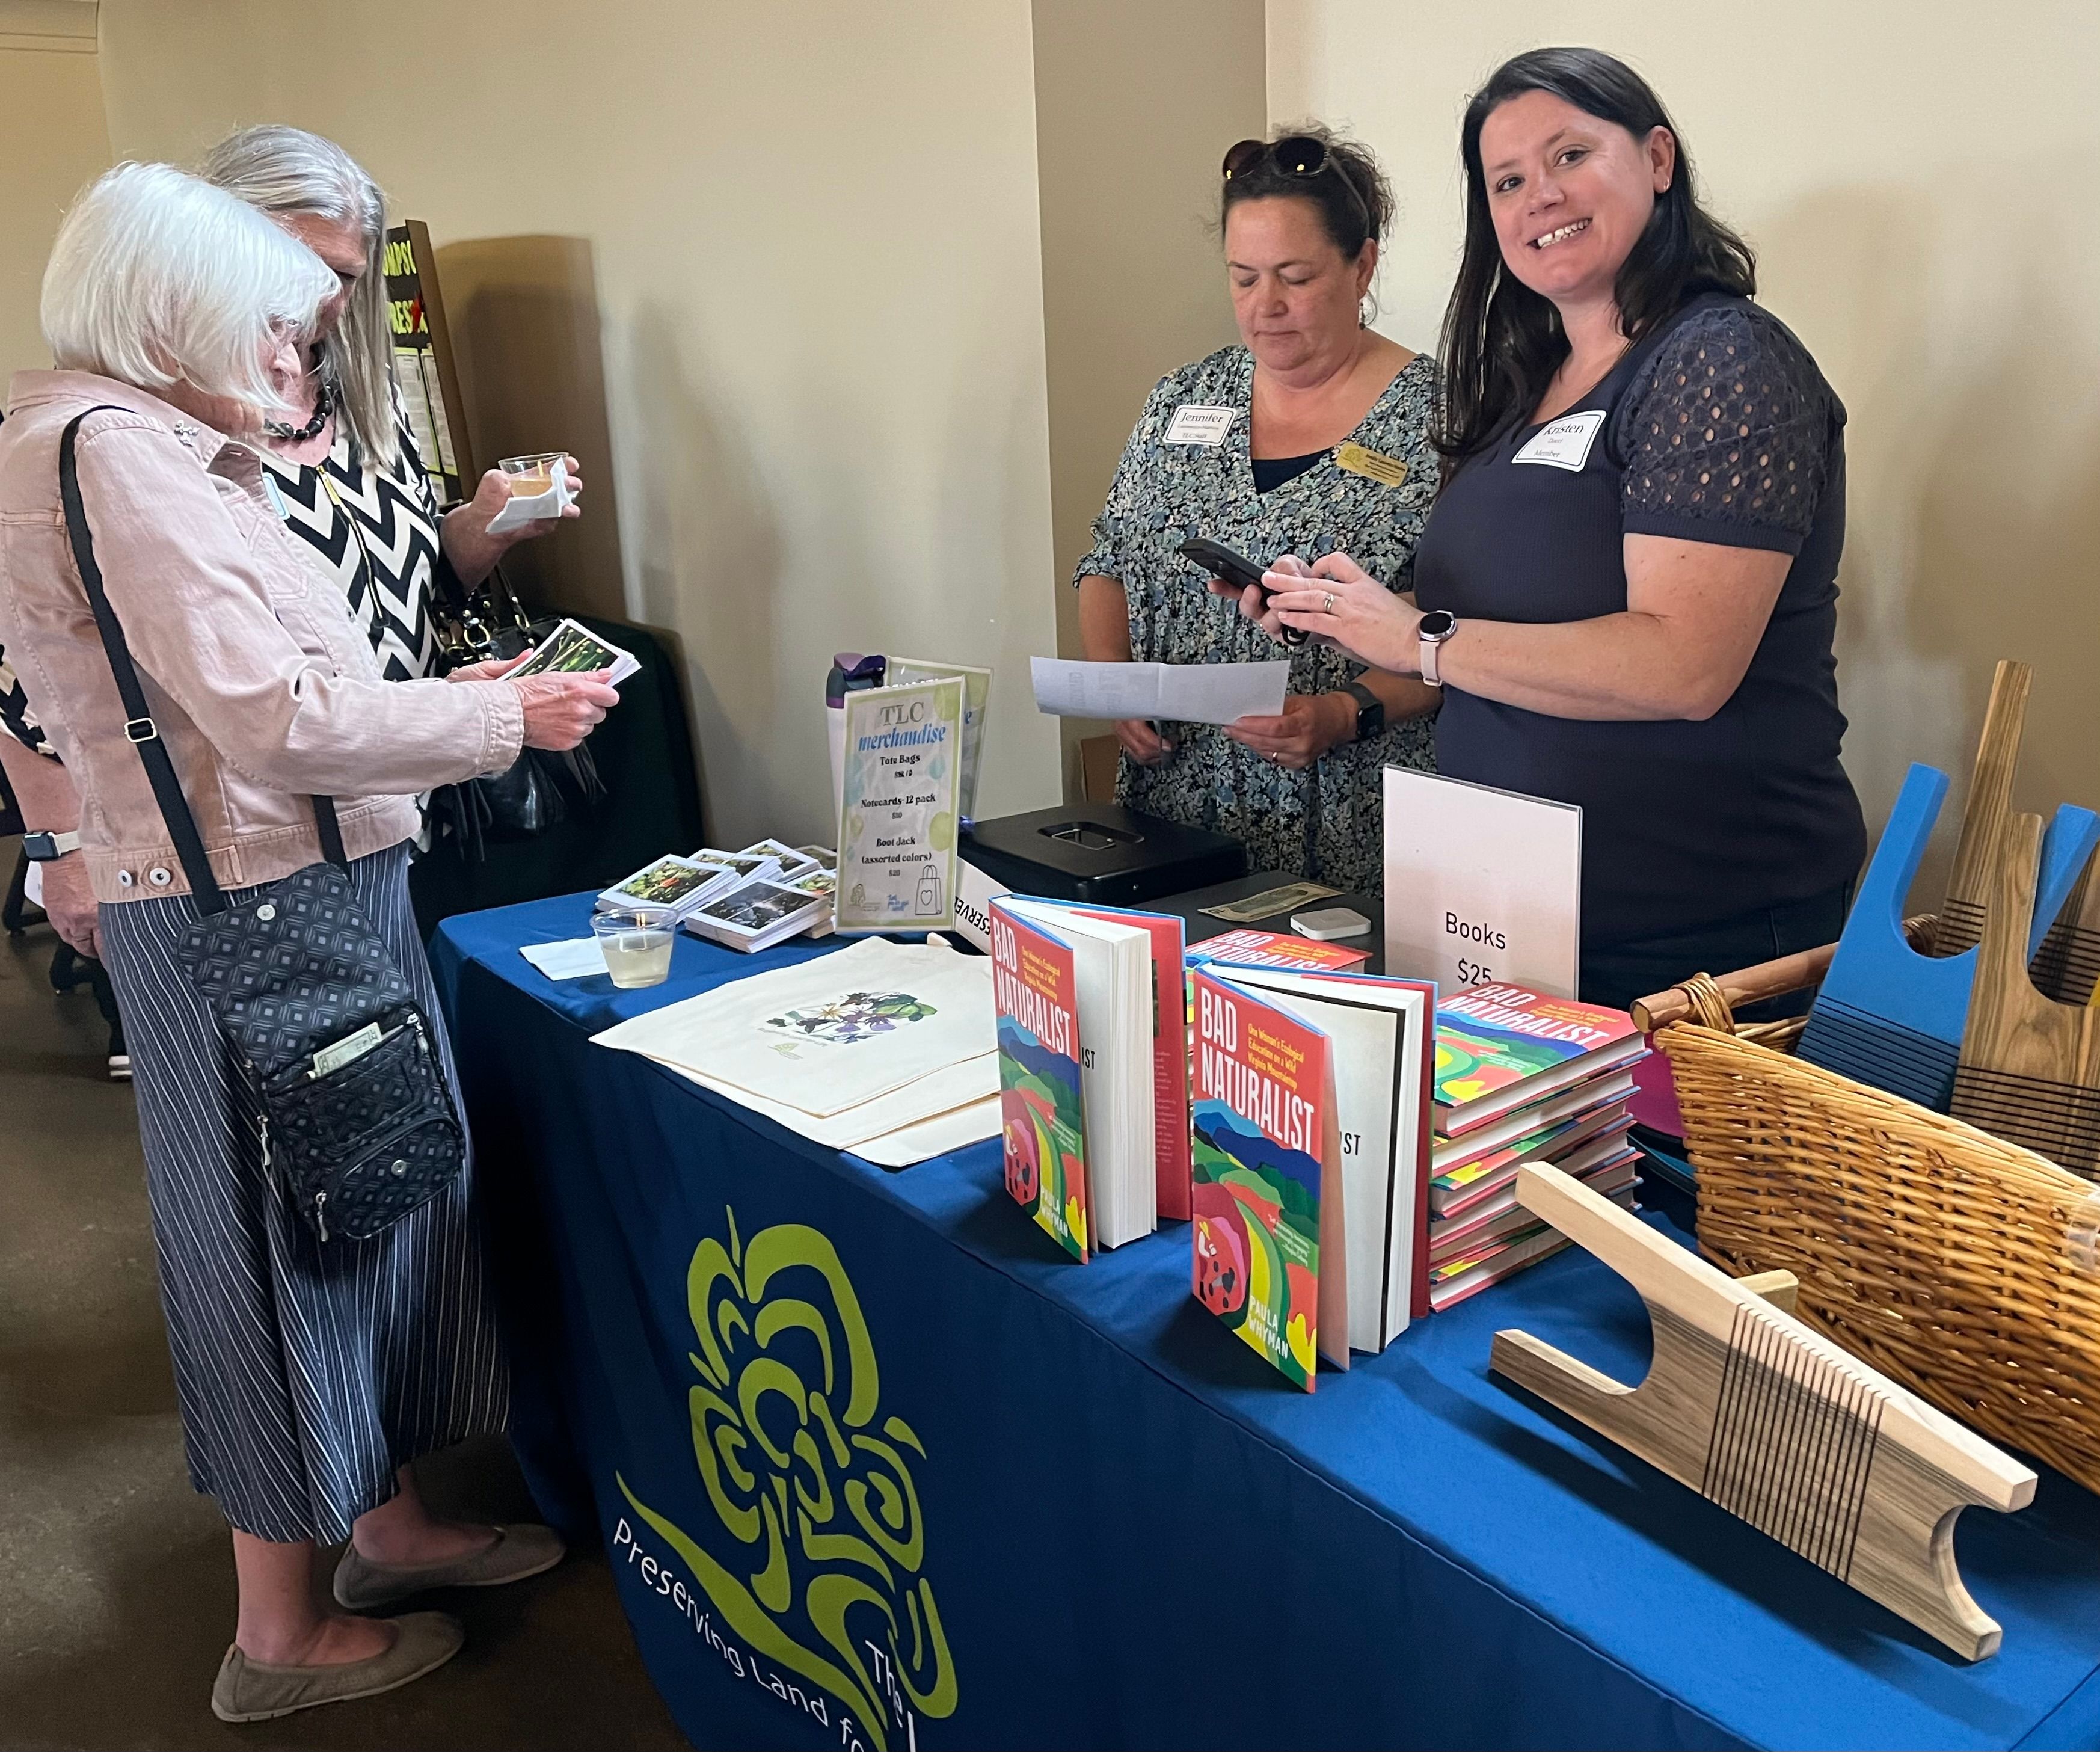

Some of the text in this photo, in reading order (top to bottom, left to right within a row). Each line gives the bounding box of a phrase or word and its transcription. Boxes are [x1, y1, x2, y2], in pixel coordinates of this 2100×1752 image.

[1180, 413, 1223, 422] Jennifer
[880, 702, 924, 726] TLC
[858, 723, 946, 751] merchandise
[880, 754, 920, 766] Tote Bags
[906, 795, 913, 804] 12
[915, 793, 936, 805] pack
[876, 836, 916, 847] Boot Jack
[862, 852, 932, 864] (assorted colors)
[992, 916, 1018, 973] BAD
[1214, 931, 1275, 948] BAD
[1446, 911, 1506, 950] Books
[1458, 957, 1491, 986] $25
[1467, 985, 1537, 1007] BAD
[996, 965, 1070, 1057] NATURALIST
[1201, 986, 1237, 1053] BAD
[1437, 995, 1610, 1045] NATURALIST
[1202, 1042, 1315, 1155] NATURALIST
[1250, 1294, 1278, 1332] PAULA
[1248, 1312, 1288, 1359] WHYMAN
[613, 1517, 745, 1677] Preserving
[749, 1656, 829, 1727] Land
